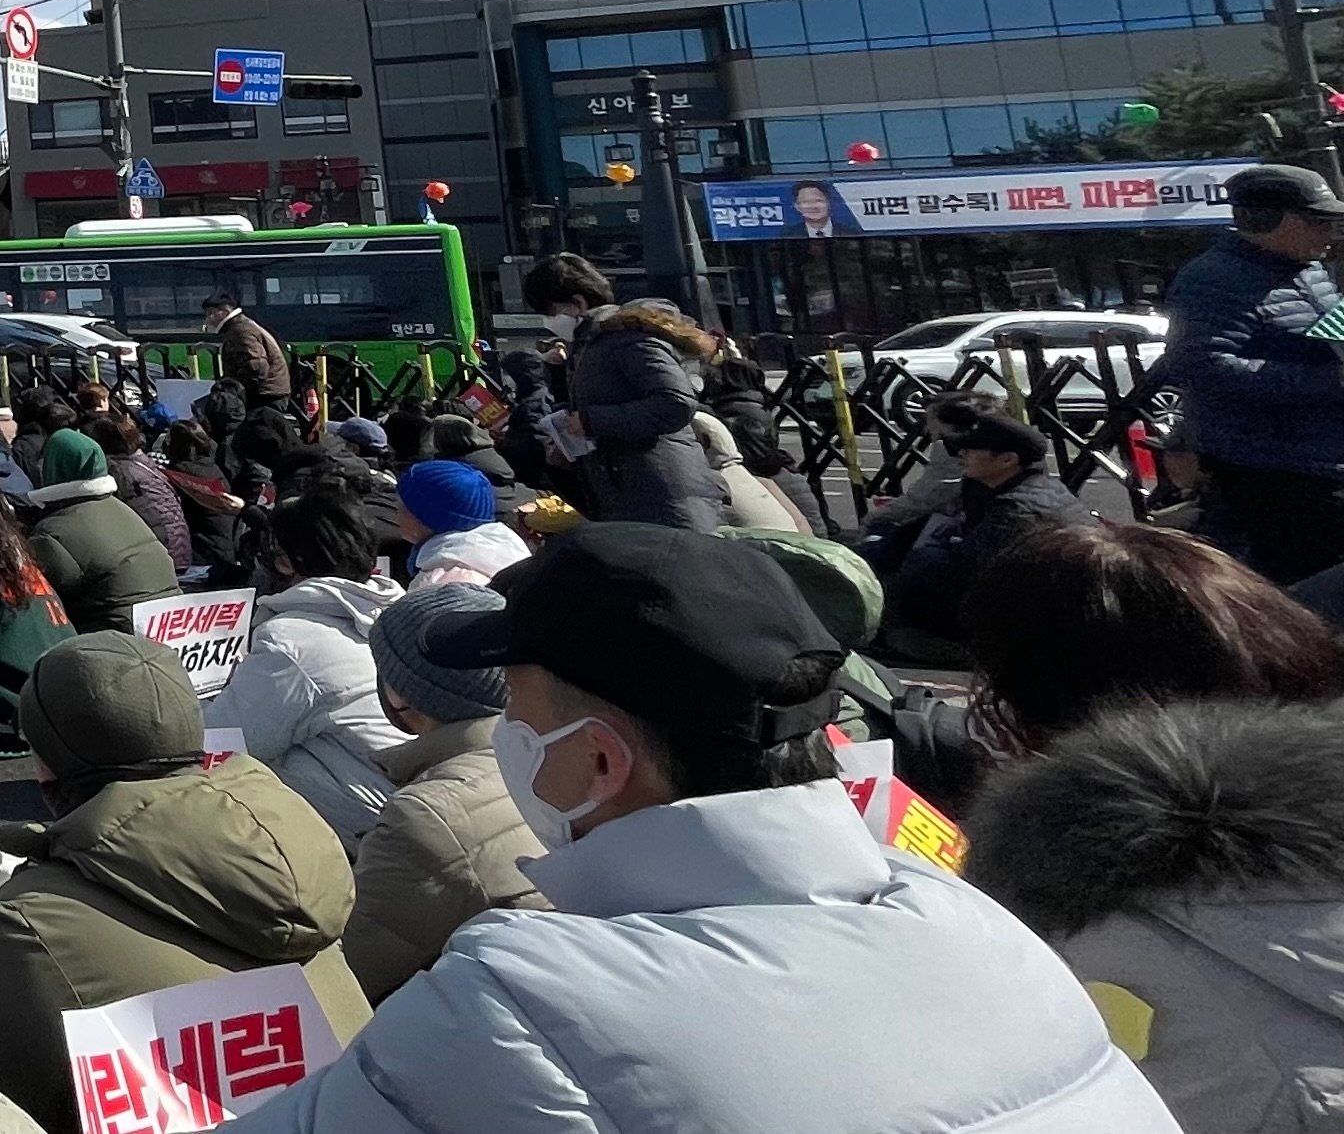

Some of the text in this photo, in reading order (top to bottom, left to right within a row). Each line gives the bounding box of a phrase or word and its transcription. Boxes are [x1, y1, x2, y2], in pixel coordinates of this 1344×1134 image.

[587, 94, 693, 115] 신아보
[713, 205, 785, 227] 곽상언
[861, 194, 910, 216] 파면
[145, 601, 247, 643] 내란세력
